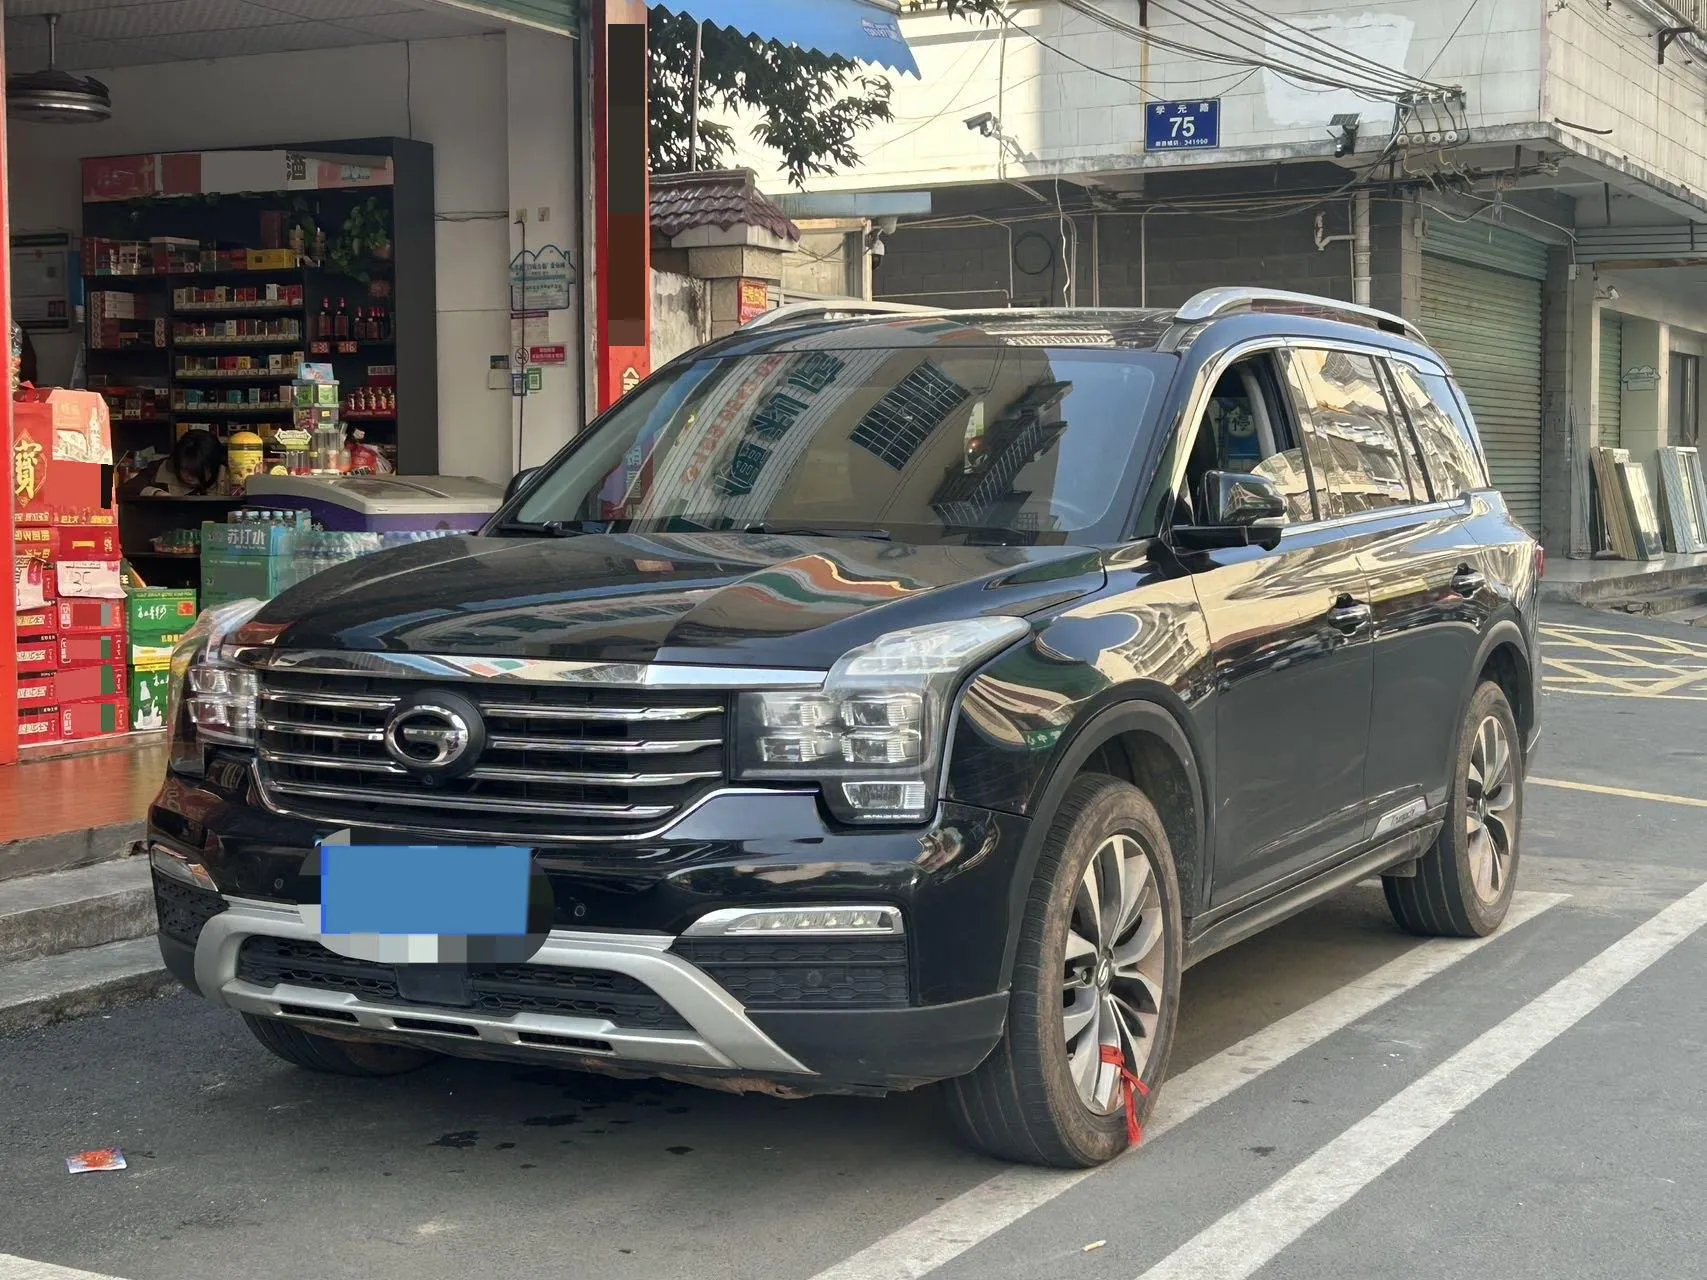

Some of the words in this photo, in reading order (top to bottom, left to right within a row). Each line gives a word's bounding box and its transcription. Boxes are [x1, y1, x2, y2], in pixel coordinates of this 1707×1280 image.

[1169, 116, 1195, 138] 75
[227, 529, 266, 545] 苏打水
